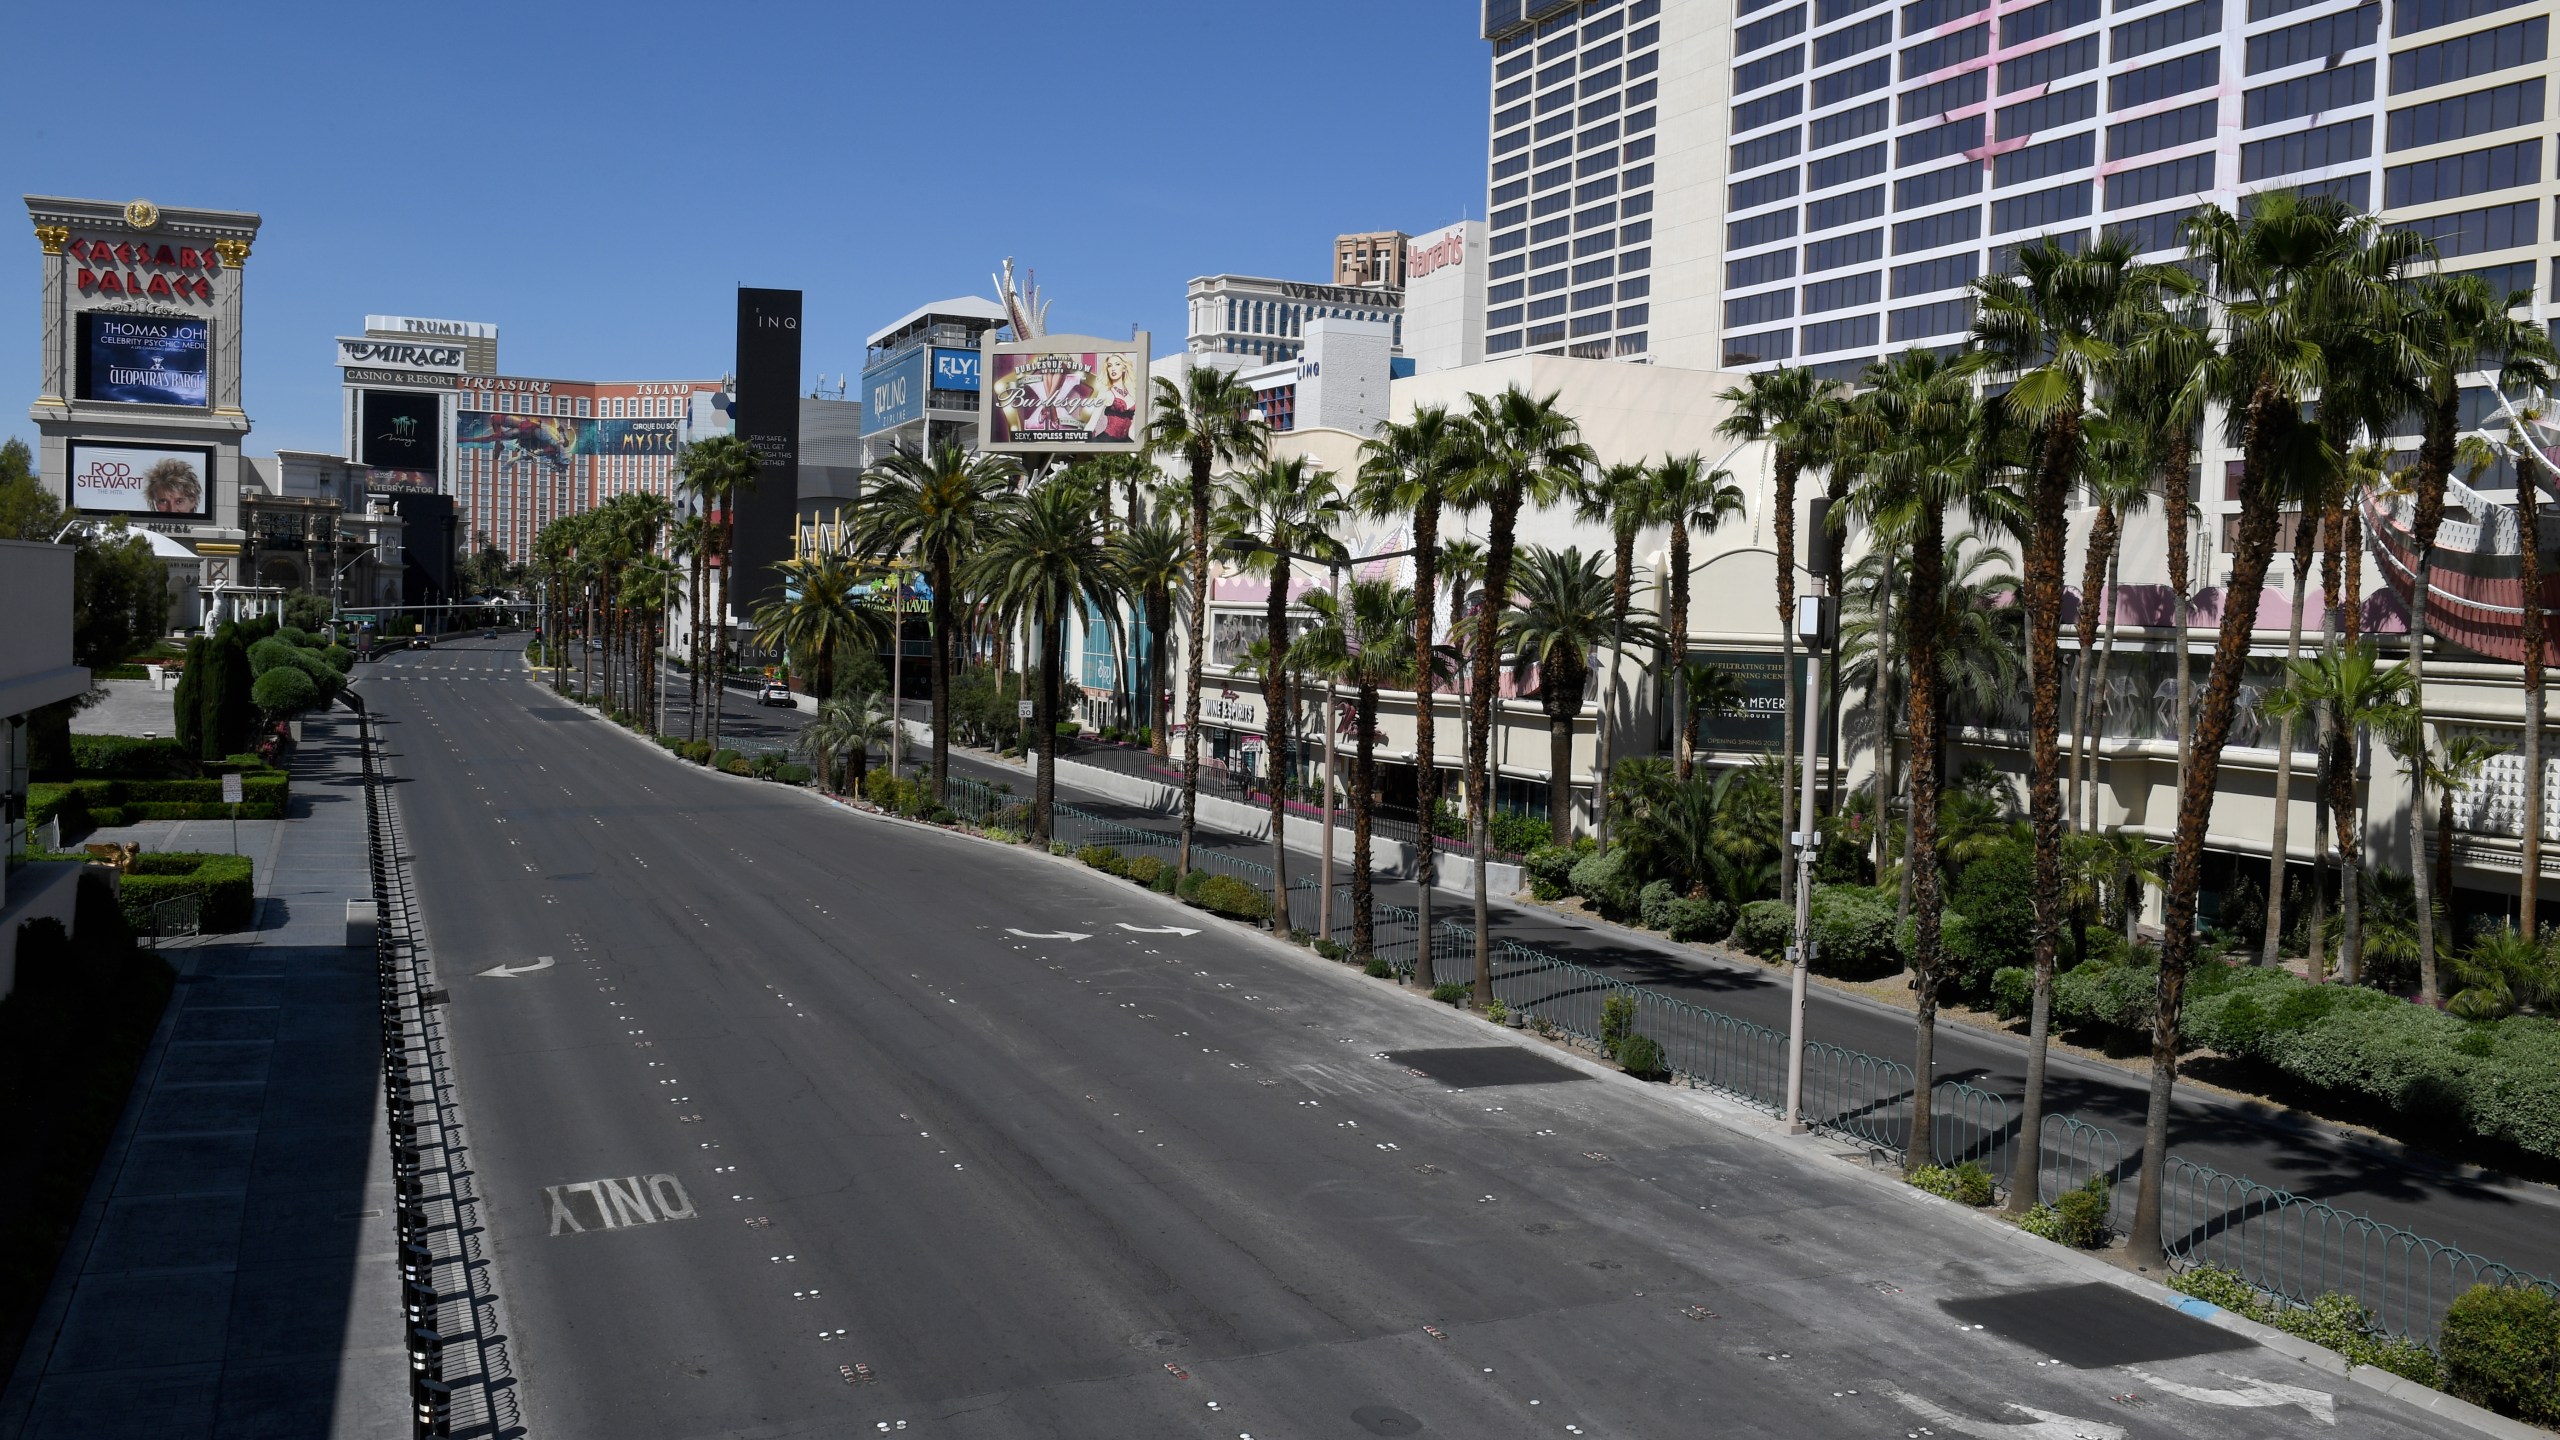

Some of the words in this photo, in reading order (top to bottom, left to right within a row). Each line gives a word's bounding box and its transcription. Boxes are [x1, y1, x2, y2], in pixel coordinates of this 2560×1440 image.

[69, 238, 216, 271] CAESARS
[78, 268, 208, 299] PALACE
[1289, 283, 1400, 307] VENETIAN
[104, 322, 168, 338] THOMAS
[404, 319, 462, 335] TRUMP
[100, 336, 142, 346] CELEBRITY
[144, 338, 181, 349] PSYCHIC
[342, 342, 369, 354] THE
[352, 344, 461, 368] MIRAGE
[1015, 360, 1063, 374] BURLESQUE
[1067, 361, 1092, 373] SHOW
[1297, 361, 1320, 381] LINQ
[110, 368, 169, 387] CLEOPATRA'S
[171, 374, 202, 389] BARGE
[346, 370, 392, 382] CASINO
[407, 374, 456, 385] RESORT
[460, 376, 552, 394] TREASURE
[636, 384, 689, 395] ISLAND
[995, 388, 1105, 415] Burlesque
[883, 409, 906, 427] ZIPLINE
[632, 422, 656, 432] CIRQUE
[1014, 432, 1032, 441] SEXY,
[1033, 432, 1063, 440] TOPLESS
[1065, 432, 1089, 440] REVUE
[91, 462, 130, 477] ROD
[77, 475, 143, 489] STEWART
[377, 484, 404, 492] TERRY
[406, 485, 434, 494] FATOR
[743, 649, 778, 658] LINQ
[1766, 663, 1784, 671] THE
[1749, 697, 1786, 709] MEYER
[1227, 702, 1254, 723] SPIRITS
[1707, 737, 1737, 745] OPENING
[546, 1173, 698, 1236] ONLY
